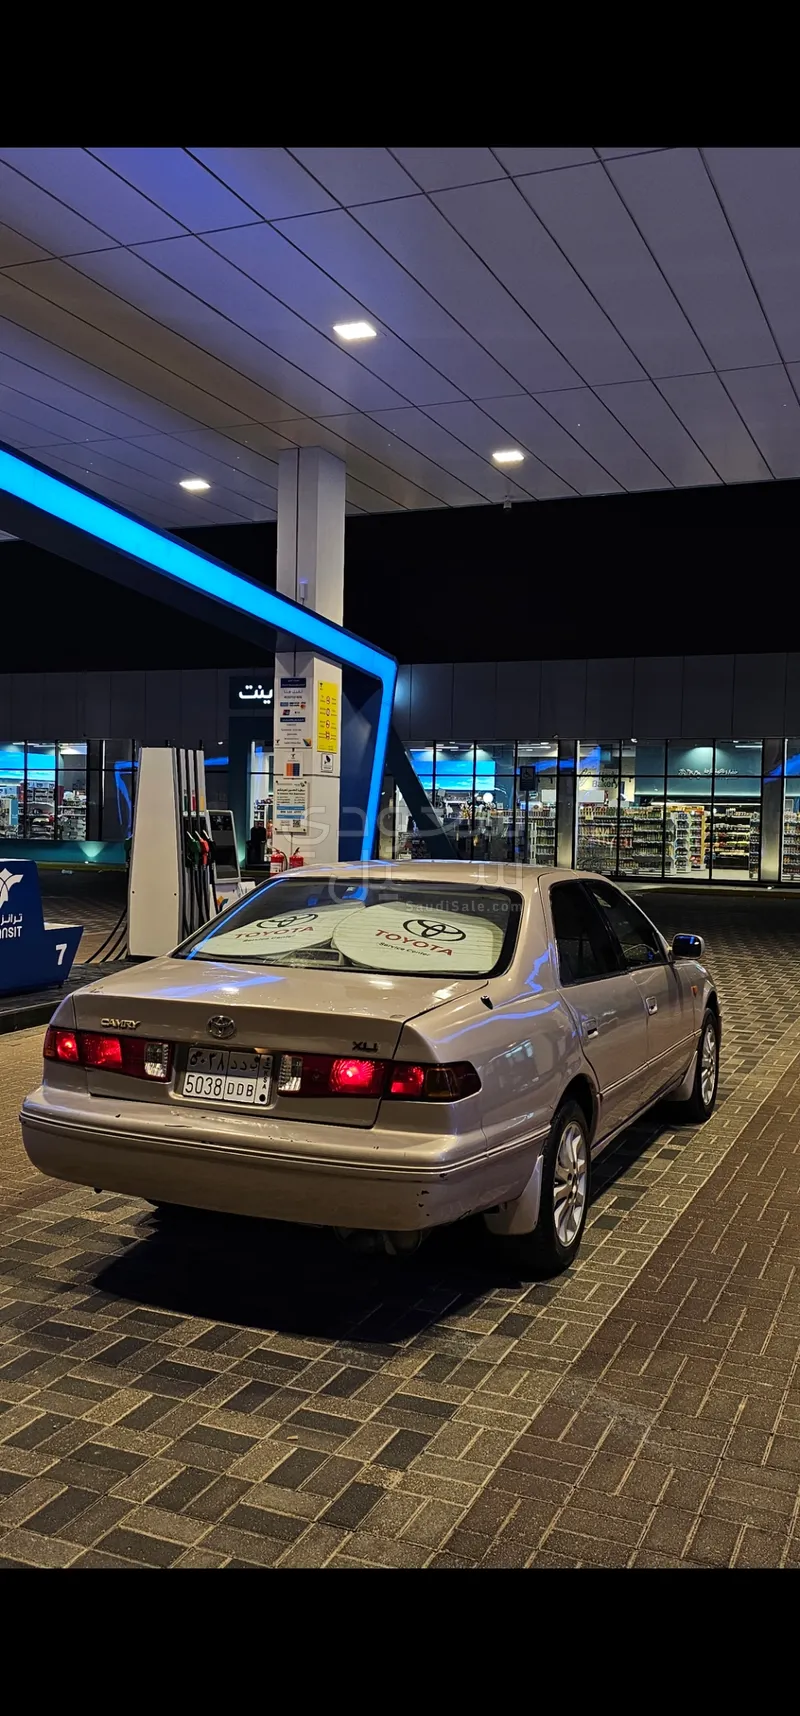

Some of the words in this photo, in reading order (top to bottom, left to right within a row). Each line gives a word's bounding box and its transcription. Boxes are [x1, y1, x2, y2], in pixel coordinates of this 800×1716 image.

[235, 926, 314, 939] TOYOTA
[375, 929, 453, 956] TOYOTA
[378, 942, 405, 951] Service
[406, 948, 431, 957] Center
[55, 943, 67, 966] 7
[100, 1017, 141, 1028] CAMRY
[185, 1074, 223, 1096] 5038
[227, 1082, 254, 1097] DDB
